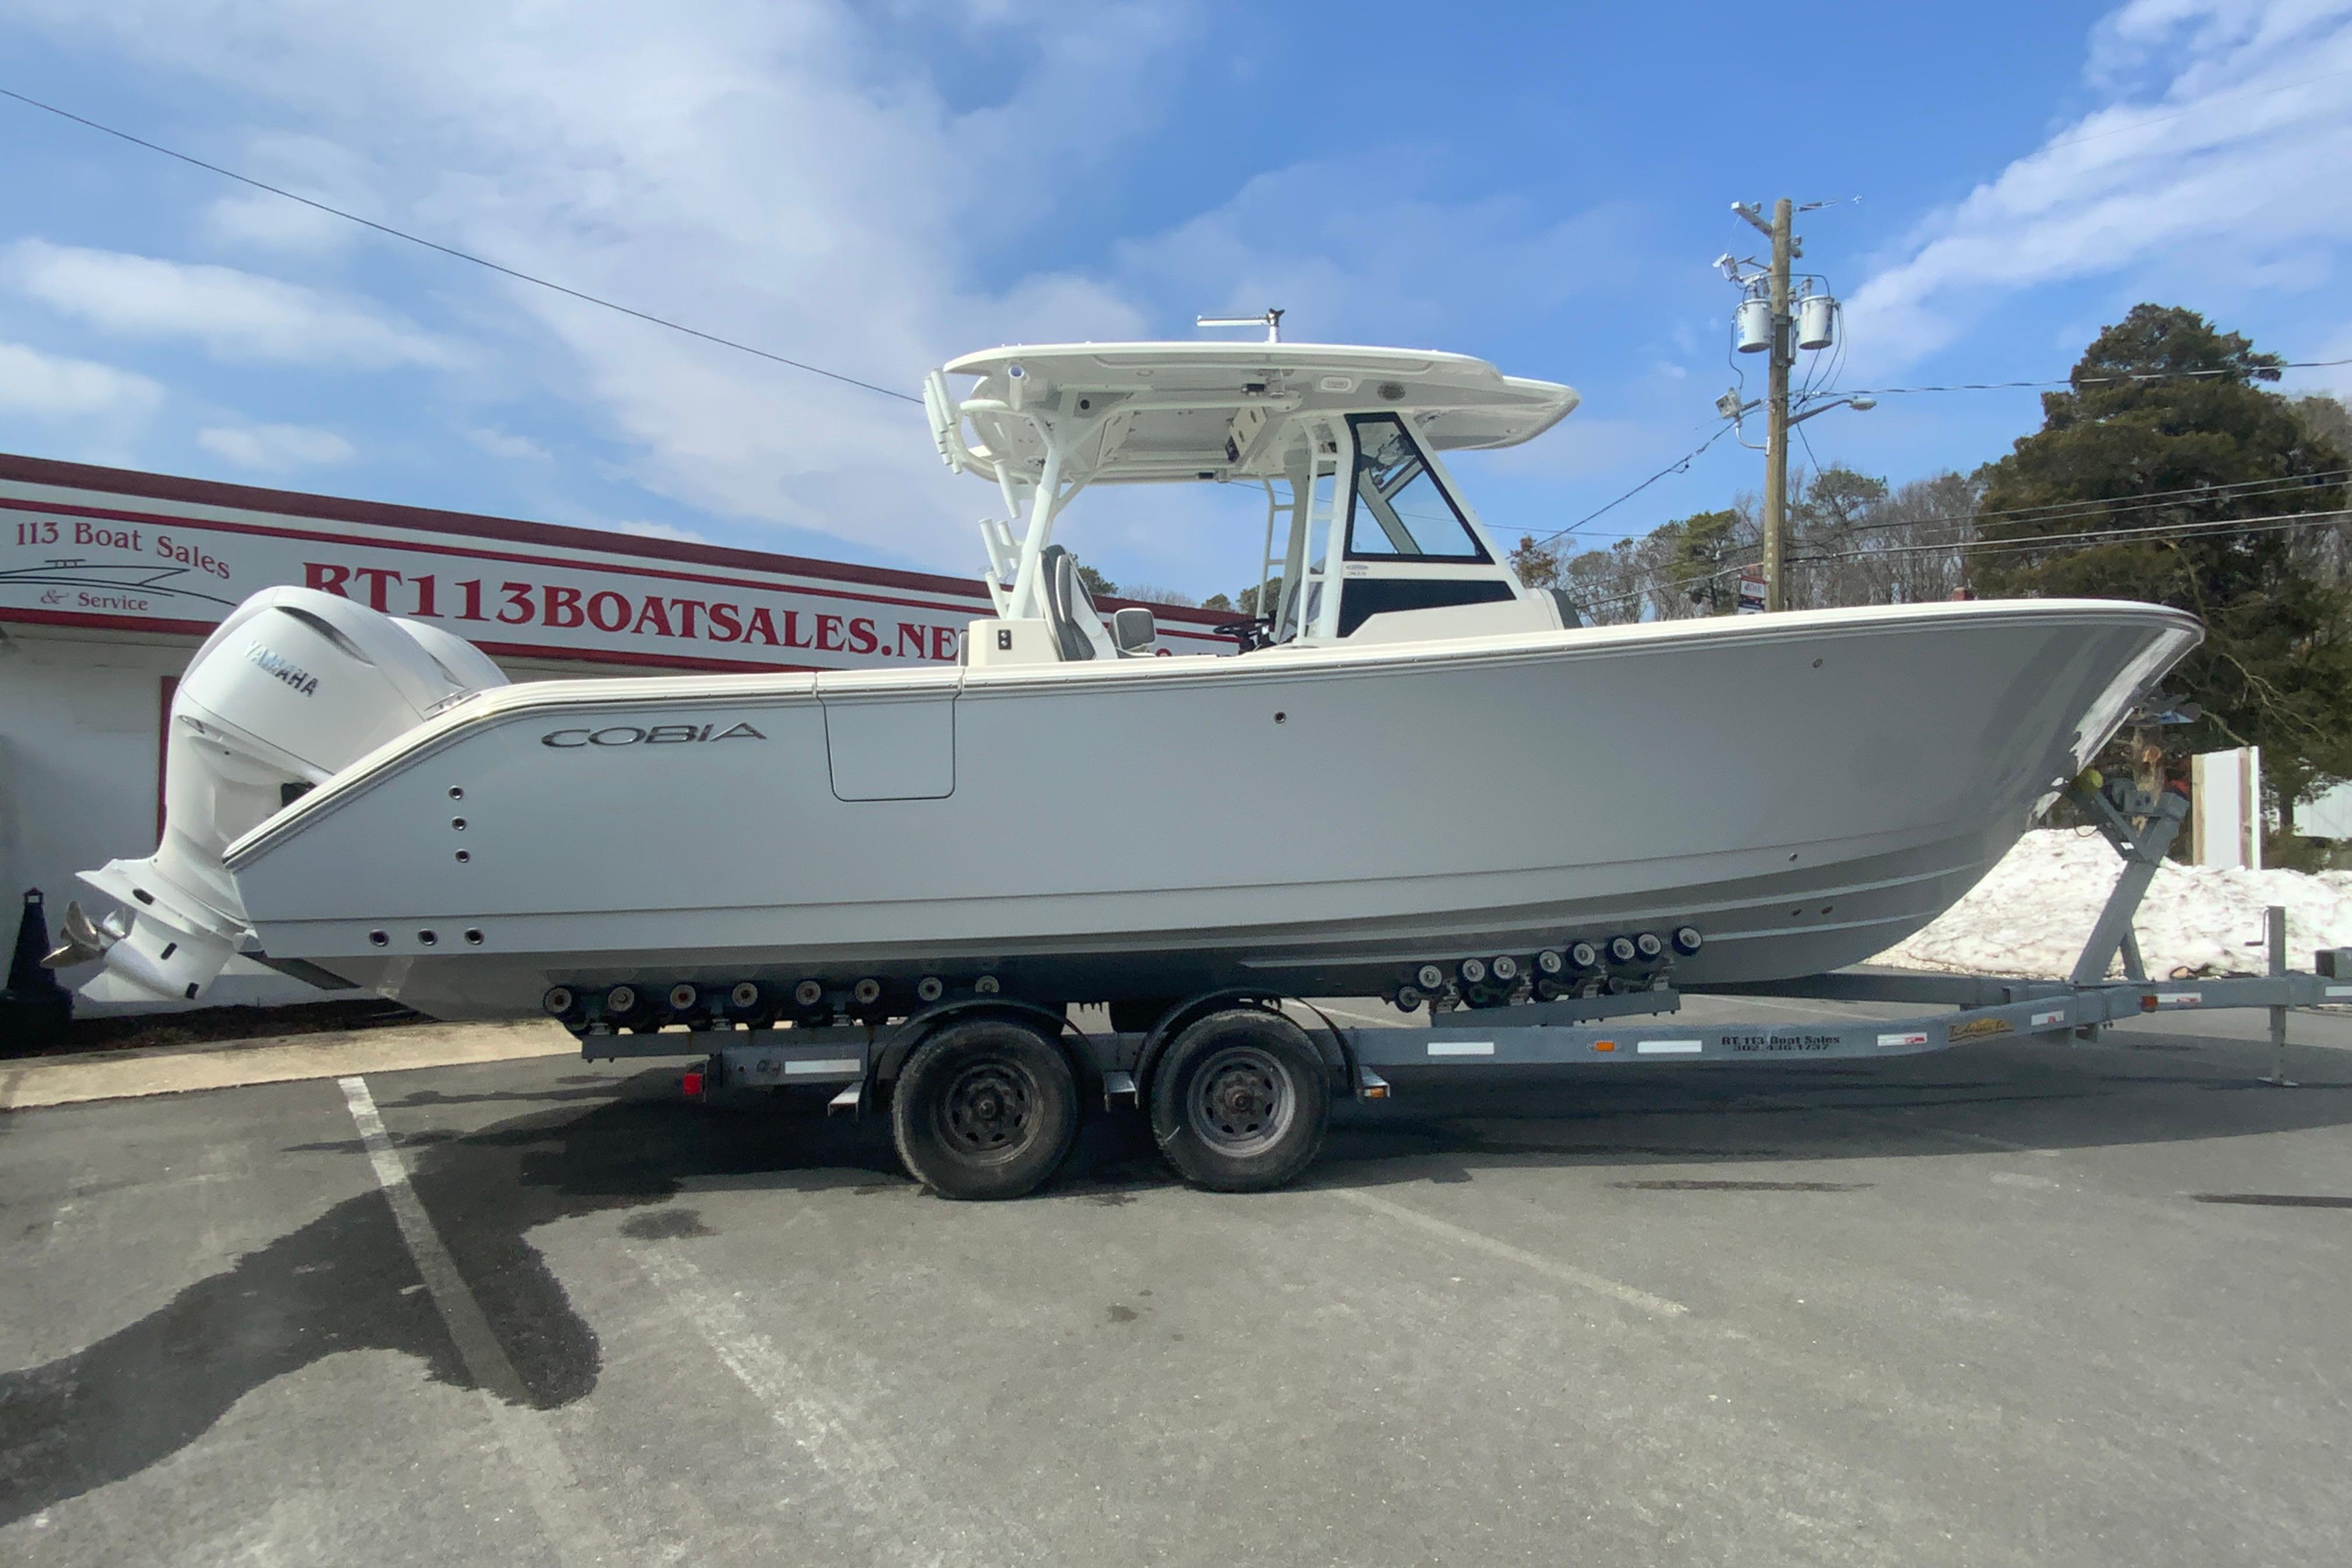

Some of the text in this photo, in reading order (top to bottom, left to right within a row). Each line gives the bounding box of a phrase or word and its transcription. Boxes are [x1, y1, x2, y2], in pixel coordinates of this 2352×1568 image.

[16, 522, 230, 579] 113 Boat Sales
[40, 589, 148, 611] & Service
[302, 562, 969, 662] RT113BOATSALES.NE
[243, 640, 318, 697] YAMAHA
[541, 722, 767, 748] COBIA
[1770, 1035, 1801, 1045] Boat
[1805, 1035, 1840, 1044] Sales
